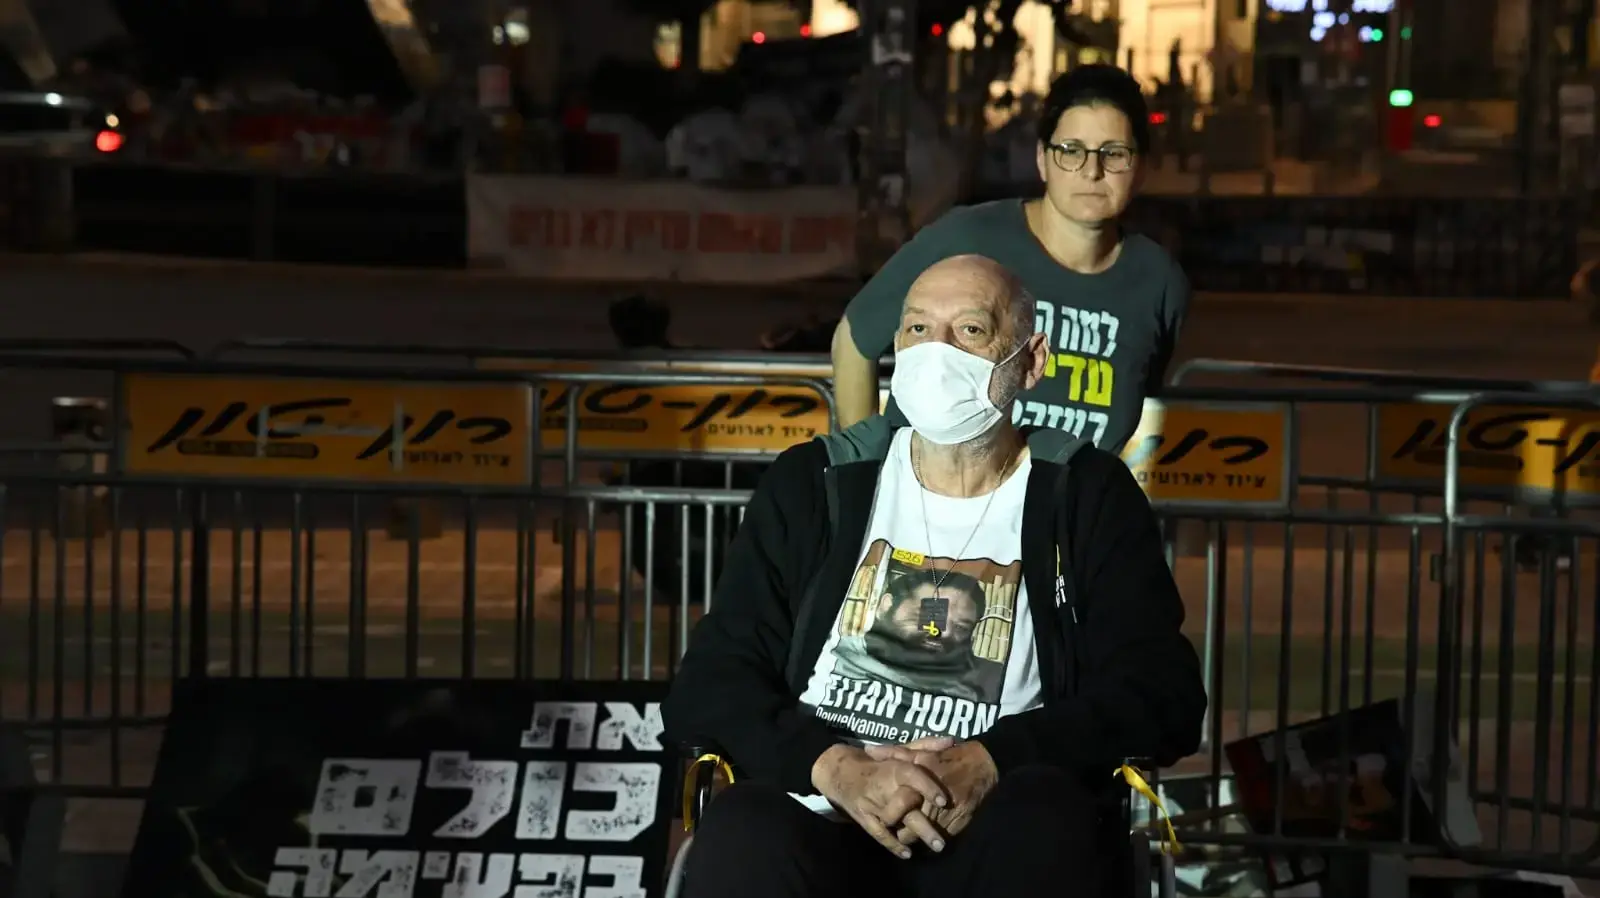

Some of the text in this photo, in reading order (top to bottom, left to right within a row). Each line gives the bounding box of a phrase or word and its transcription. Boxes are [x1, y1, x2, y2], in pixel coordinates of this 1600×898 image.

[1035, 300, 1119, 358] למה ה
[1044, 352, 1114, 408] עדי
[520, 701, 665, 751] את
[823, 674, 998, 739] EITAN HORN
[310, 749, 662, 842] כולם
